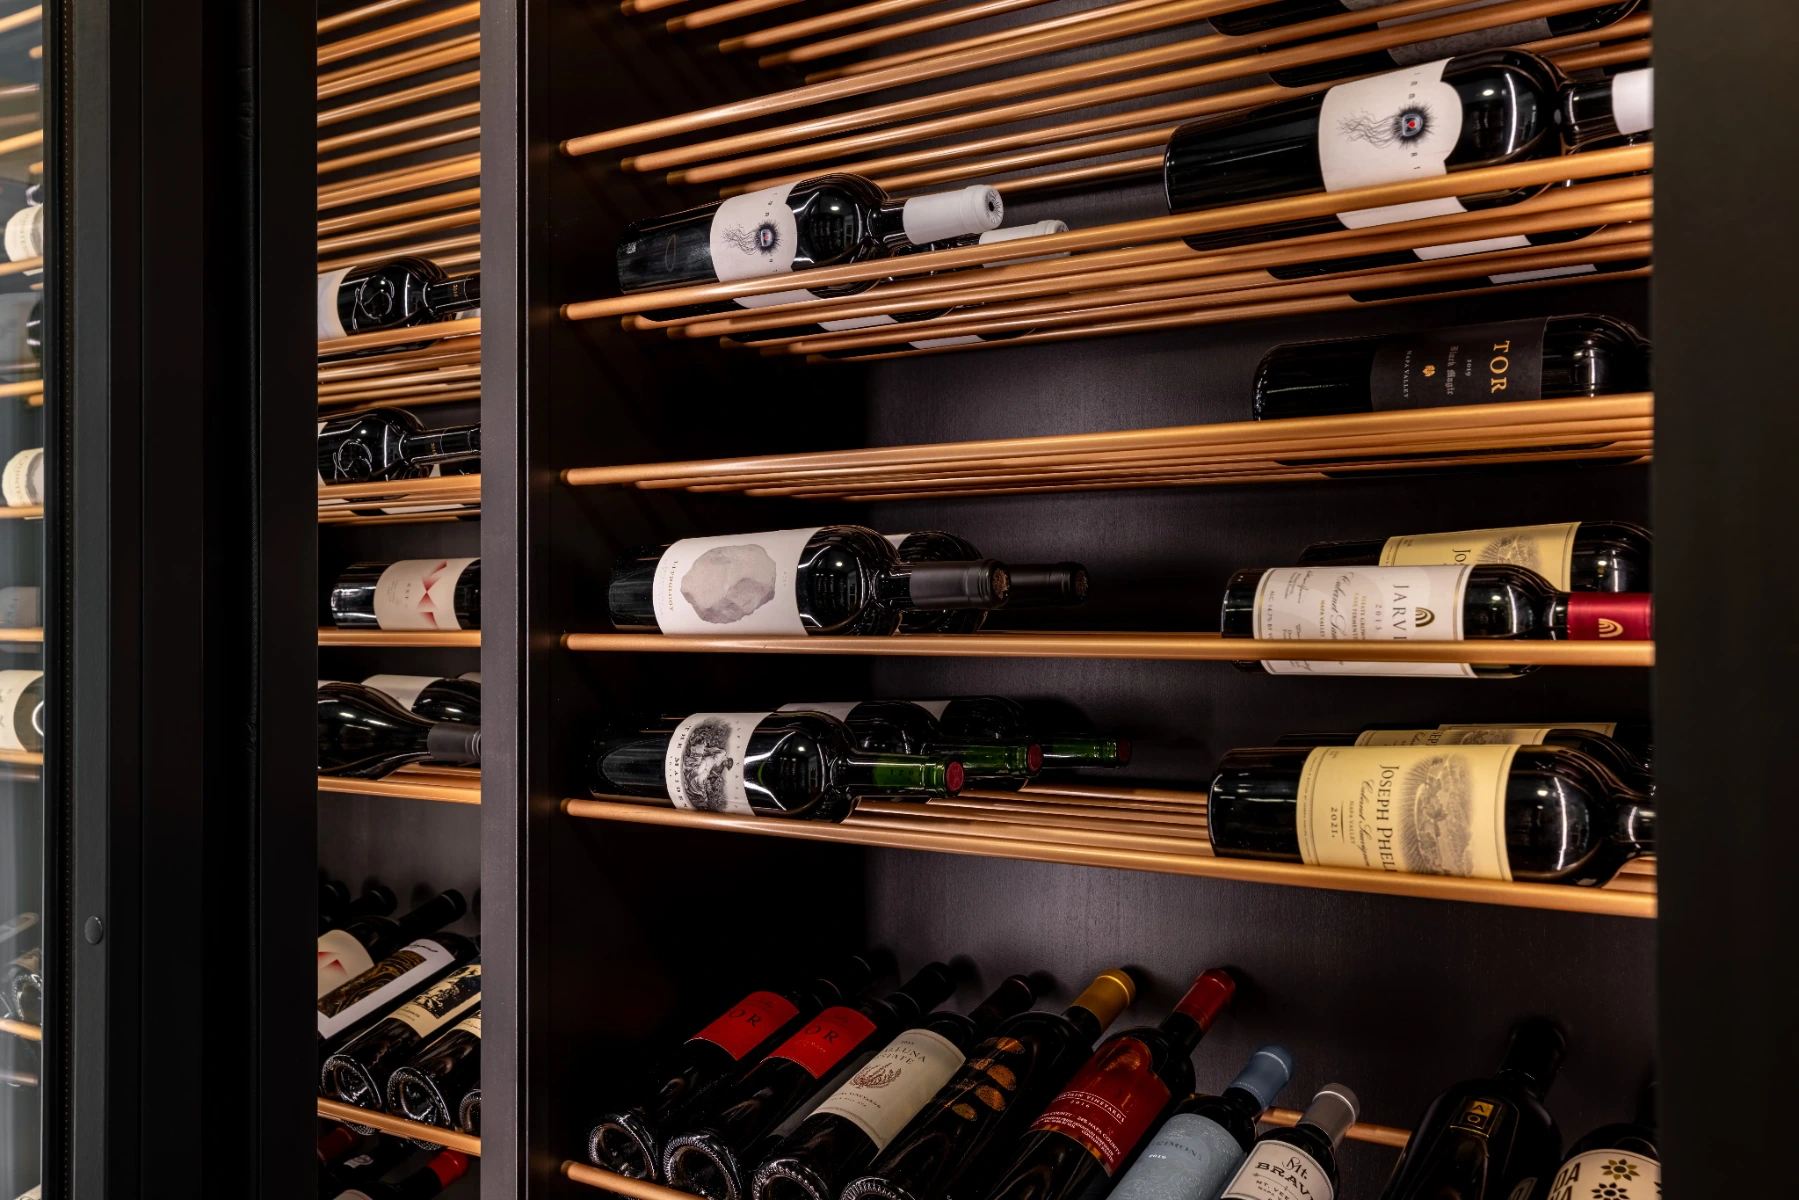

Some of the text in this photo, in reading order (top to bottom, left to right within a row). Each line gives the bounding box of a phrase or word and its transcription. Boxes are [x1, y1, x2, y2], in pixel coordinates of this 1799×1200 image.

[1403, 350, 1412, 368] NAPA
[1444, 345, 1459, 395] Black Magic
[1489, 340, 1511, 394] TOR
[1330, 571, 1355, 616] Cabernet
[1392, 584, 1410, 640] JARVI
[1351, 607, 1359, 640] FERMENT
[1357, 779, 1375, 867] Cabernet Sauvignon
[1376, 764, 1399, 872] JOSEPH PHEL
[728, 1009, 762, 1028] OR
[804, 1025, 839, 1044] OR
[1086, 1094, 1126, 1124] VINEYARDS
[1102, 1133, 1121, 1155] COUNTY
[1254, 1161, 1314, 1200] BRAV
